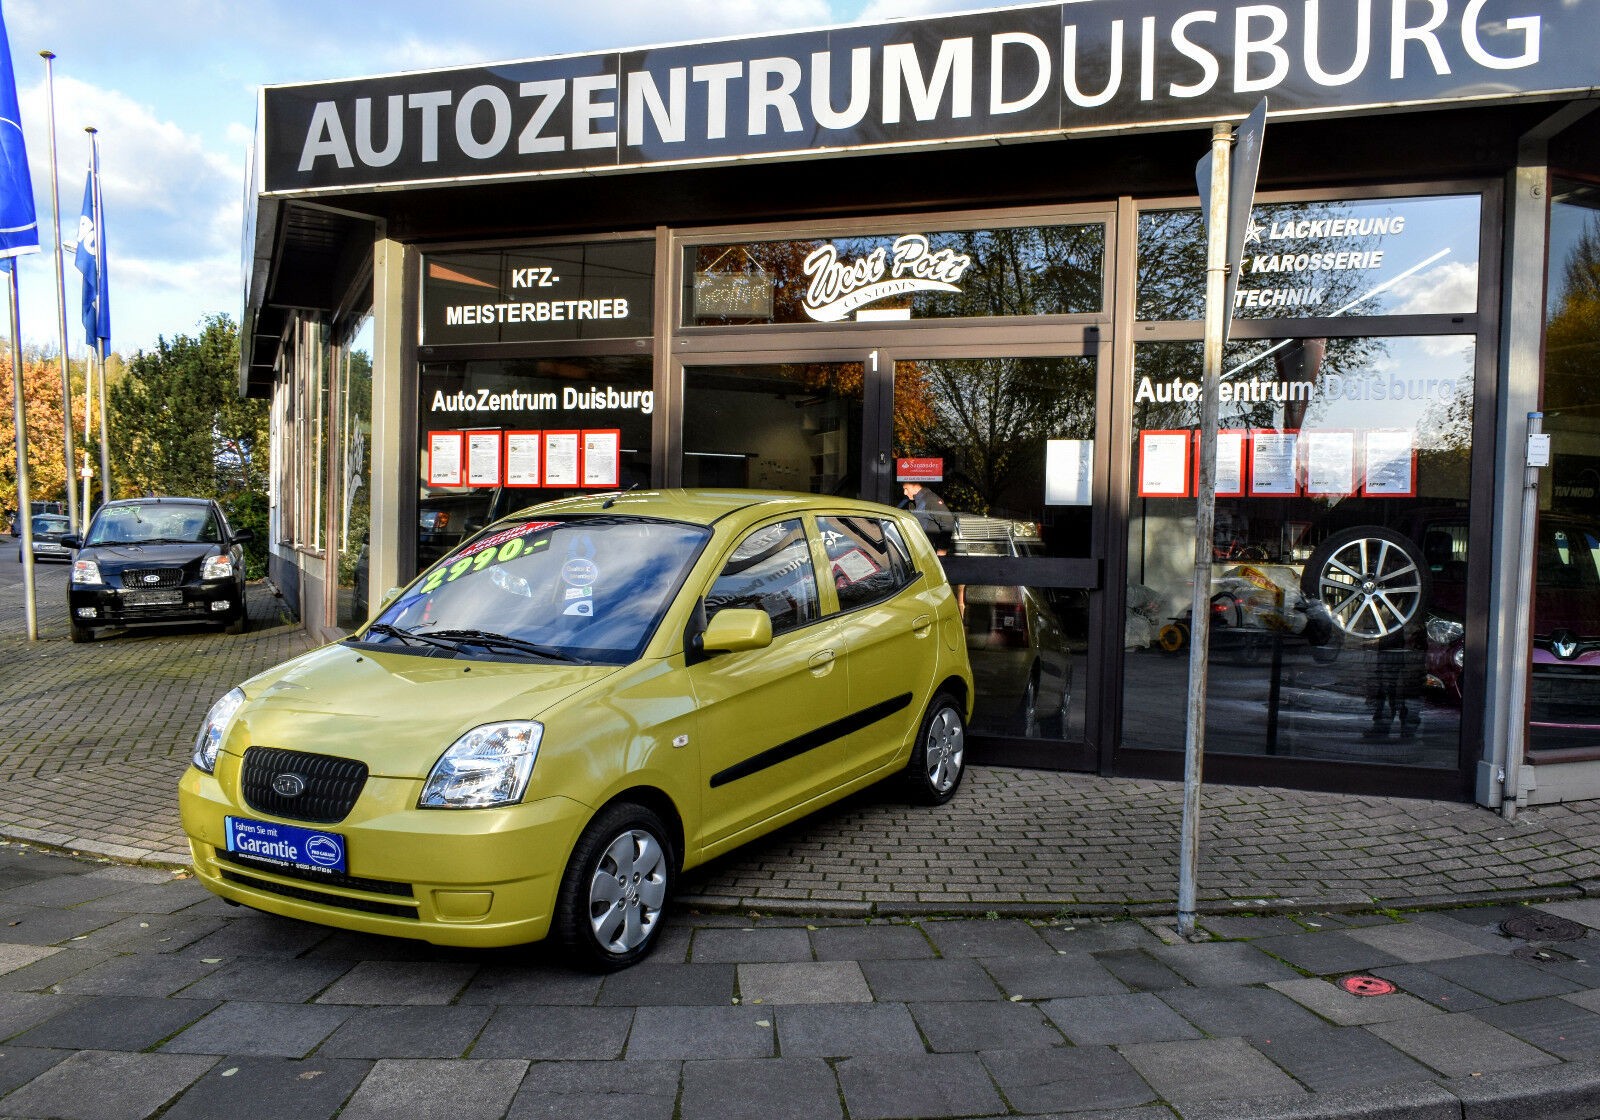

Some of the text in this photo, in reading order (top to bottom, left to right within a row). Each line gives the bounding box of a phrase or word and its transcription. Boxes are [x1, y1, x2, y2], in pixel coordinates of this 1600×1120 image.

[1269, 216, 1405, 240] LACKIERUNG
[803, 234, 971, 308] West Pott
[1251, 251, 1385, 273] KAROSSERIE
[512, 267, 560, 288] KFZ-
[844, 282, 917, 308] CUSTOMS
[1234, 287, 1326, 308] TECHNIK
[446, 298, 629, 325] MEISTERBETRIEB
[868, 350, 879, 372] 1
[431, 386, 654, 414] AutoZentrum Duisburg
[1135, 373, 1457, 405] Autoentrum Duisburg
[909, 461, 939, 469] Santander
[235, 822, 278, 837] Fahren Sie mit
[236, 833, 298, 860] Garantie
